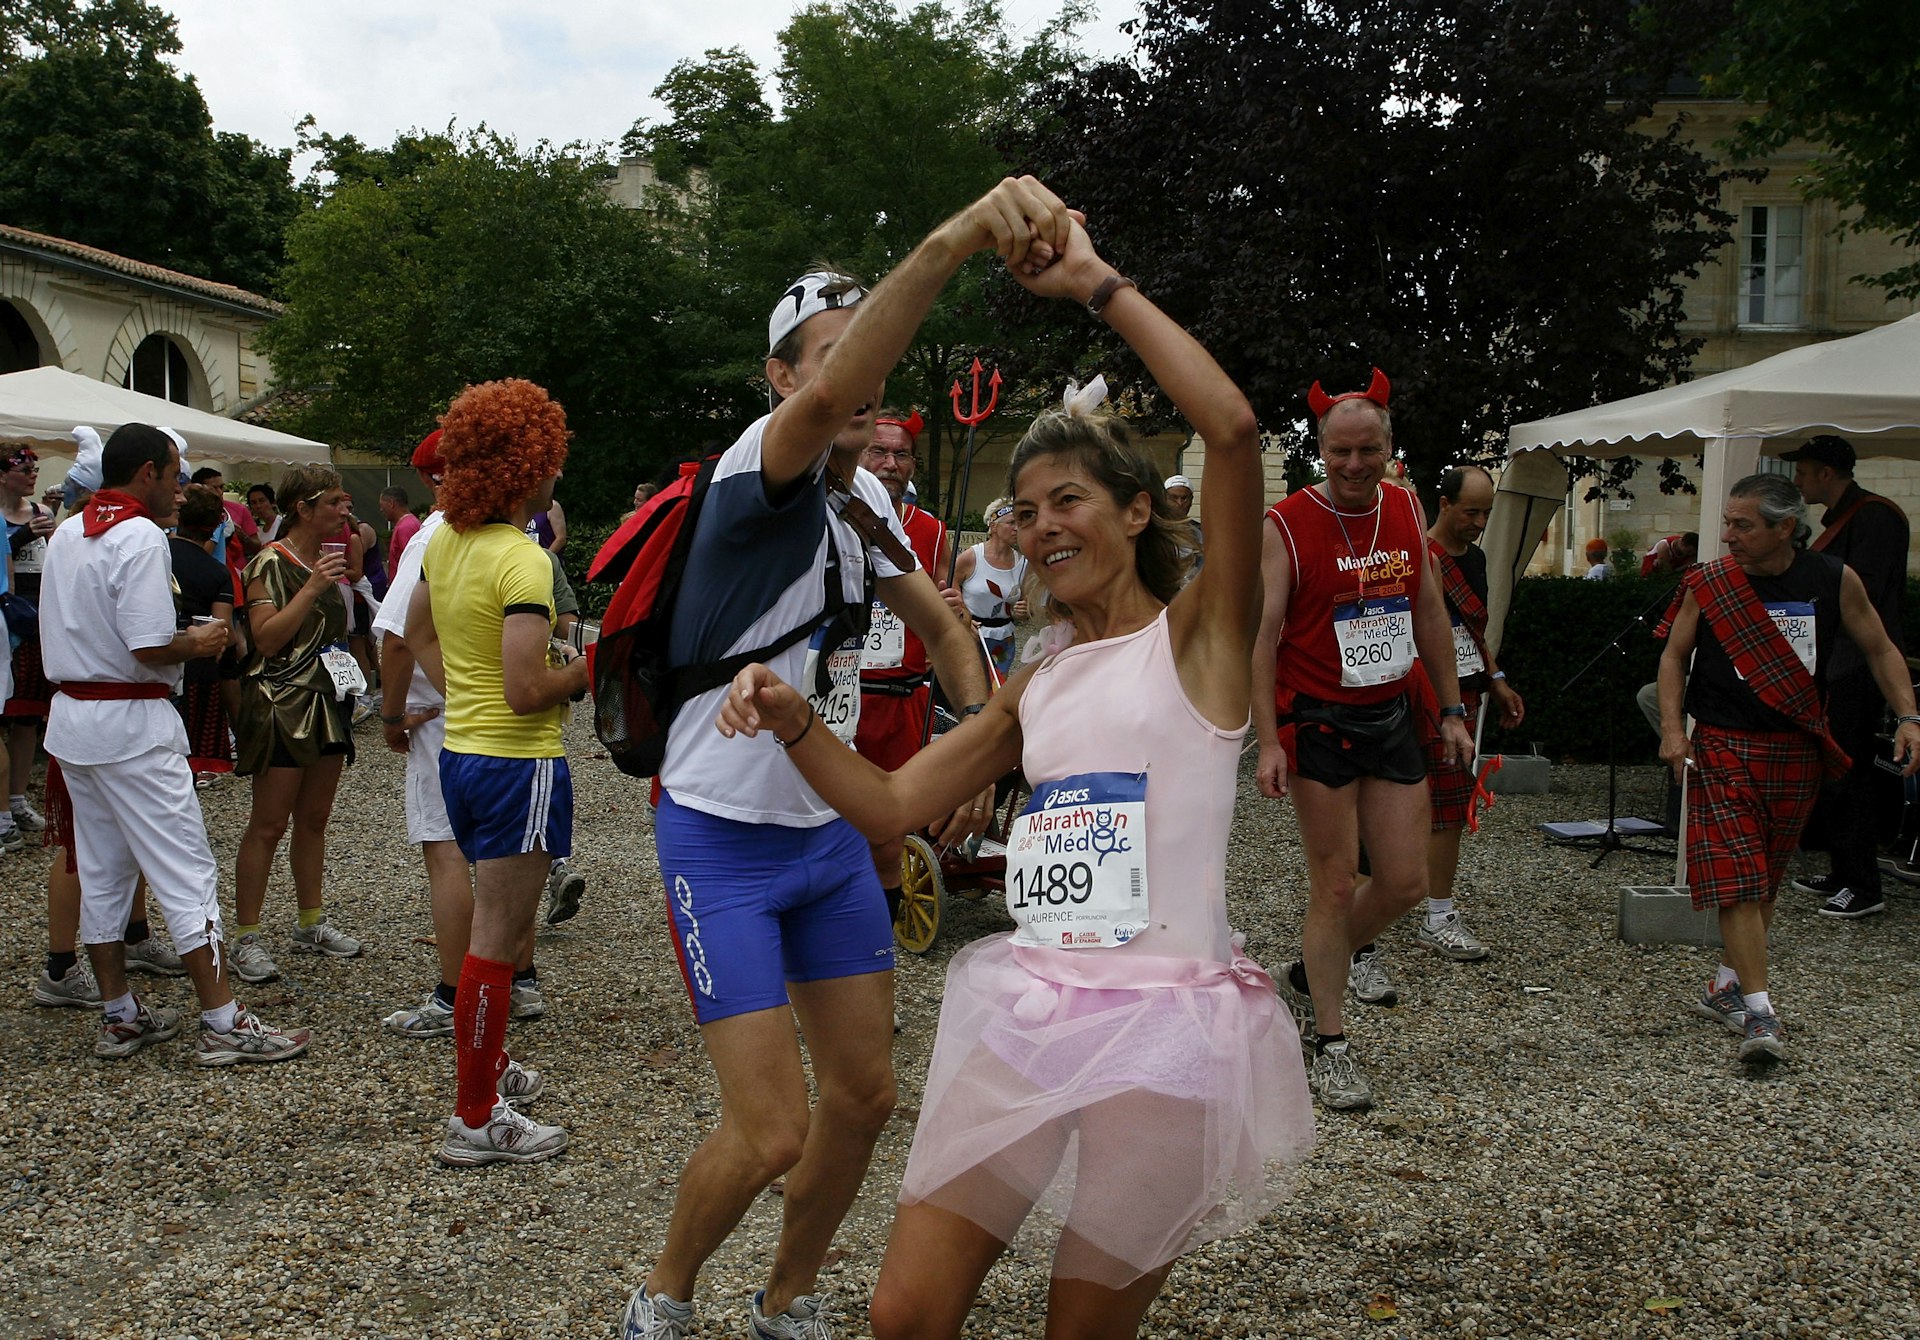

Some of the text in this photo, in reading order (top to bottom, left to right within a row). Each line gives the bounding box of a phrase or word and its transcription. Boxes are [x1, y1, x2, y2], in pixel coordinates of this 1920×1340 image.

[1344, 641, 1392, 667] 8260
[1057, 788, 1091, 804] asics
[1028, 806, 1128, 834] Marathon
[1045, 829, 1132, 856] Médoc
[1013, 862, 1093, 909] 1489
[1027, 911, 1073, 923] LAURENCE
